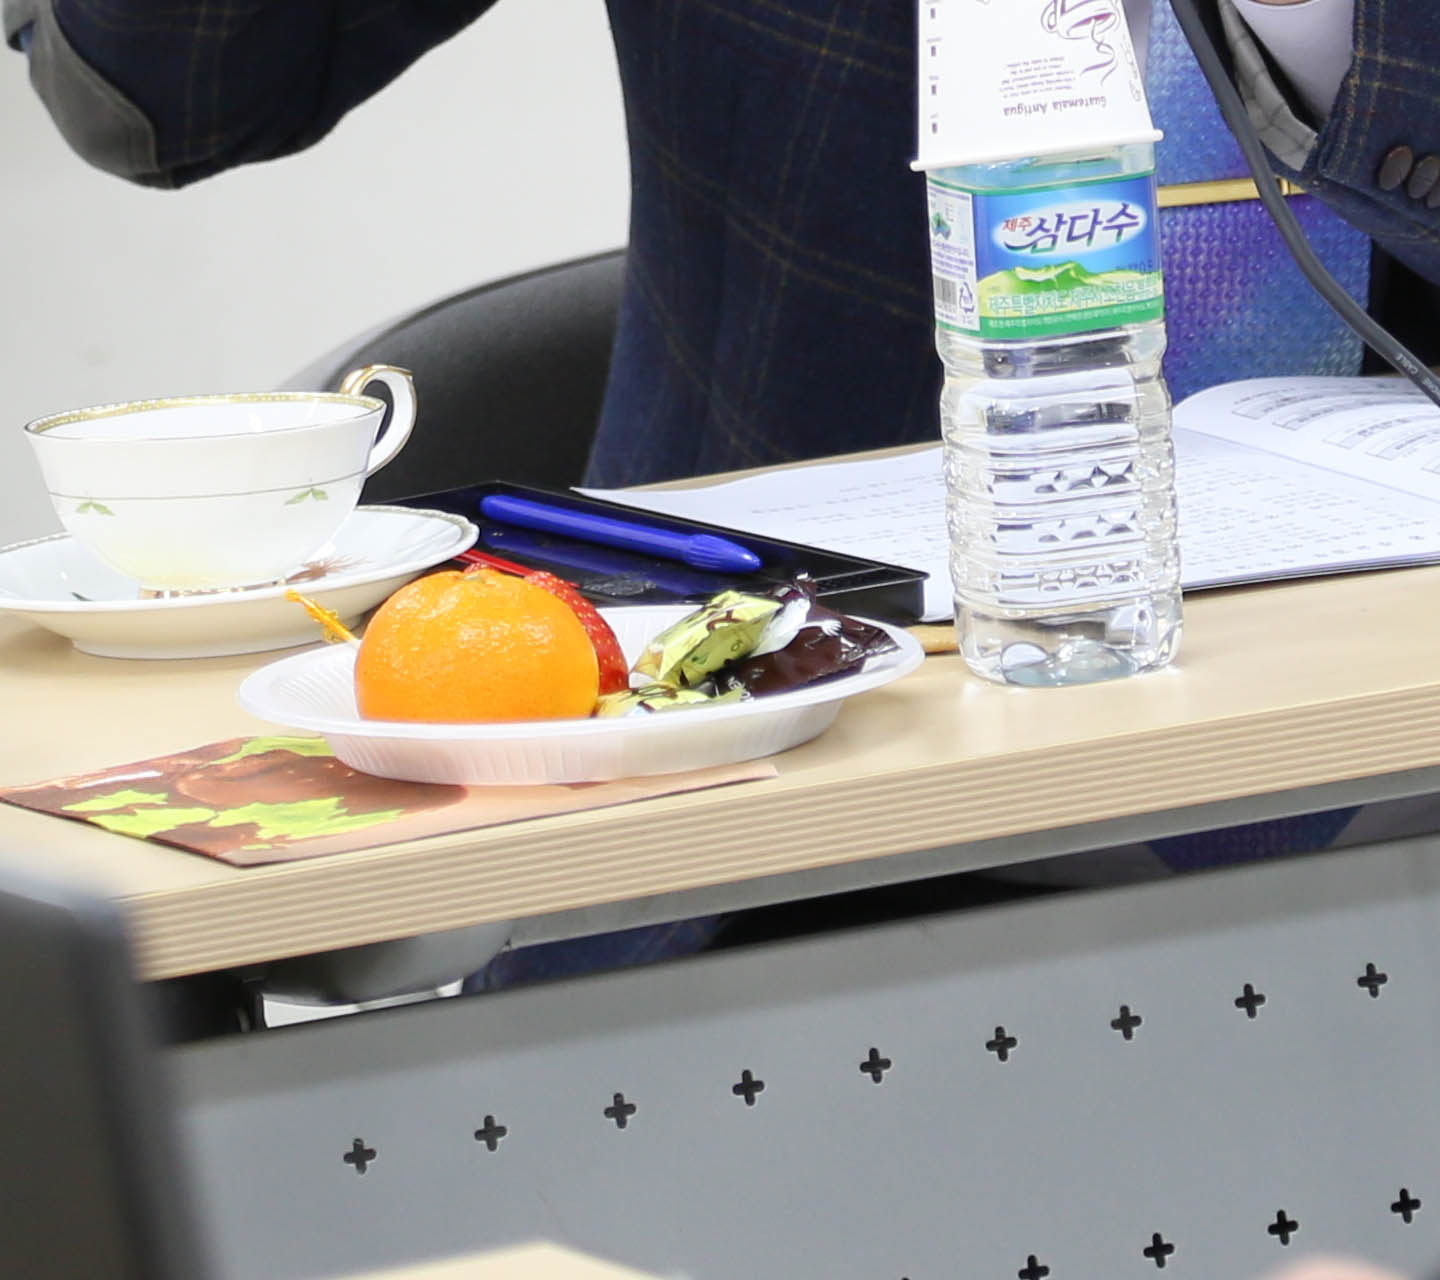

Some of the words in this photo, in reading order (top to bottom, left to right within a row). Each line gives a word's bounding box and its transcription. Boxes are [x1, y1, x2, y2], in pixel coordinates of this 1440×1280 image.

[1003, 102, 1047, 117] Antigua
[1002, 215, 1033, 233] 제주
[1010, 202, 1141, 254] 삼다수
